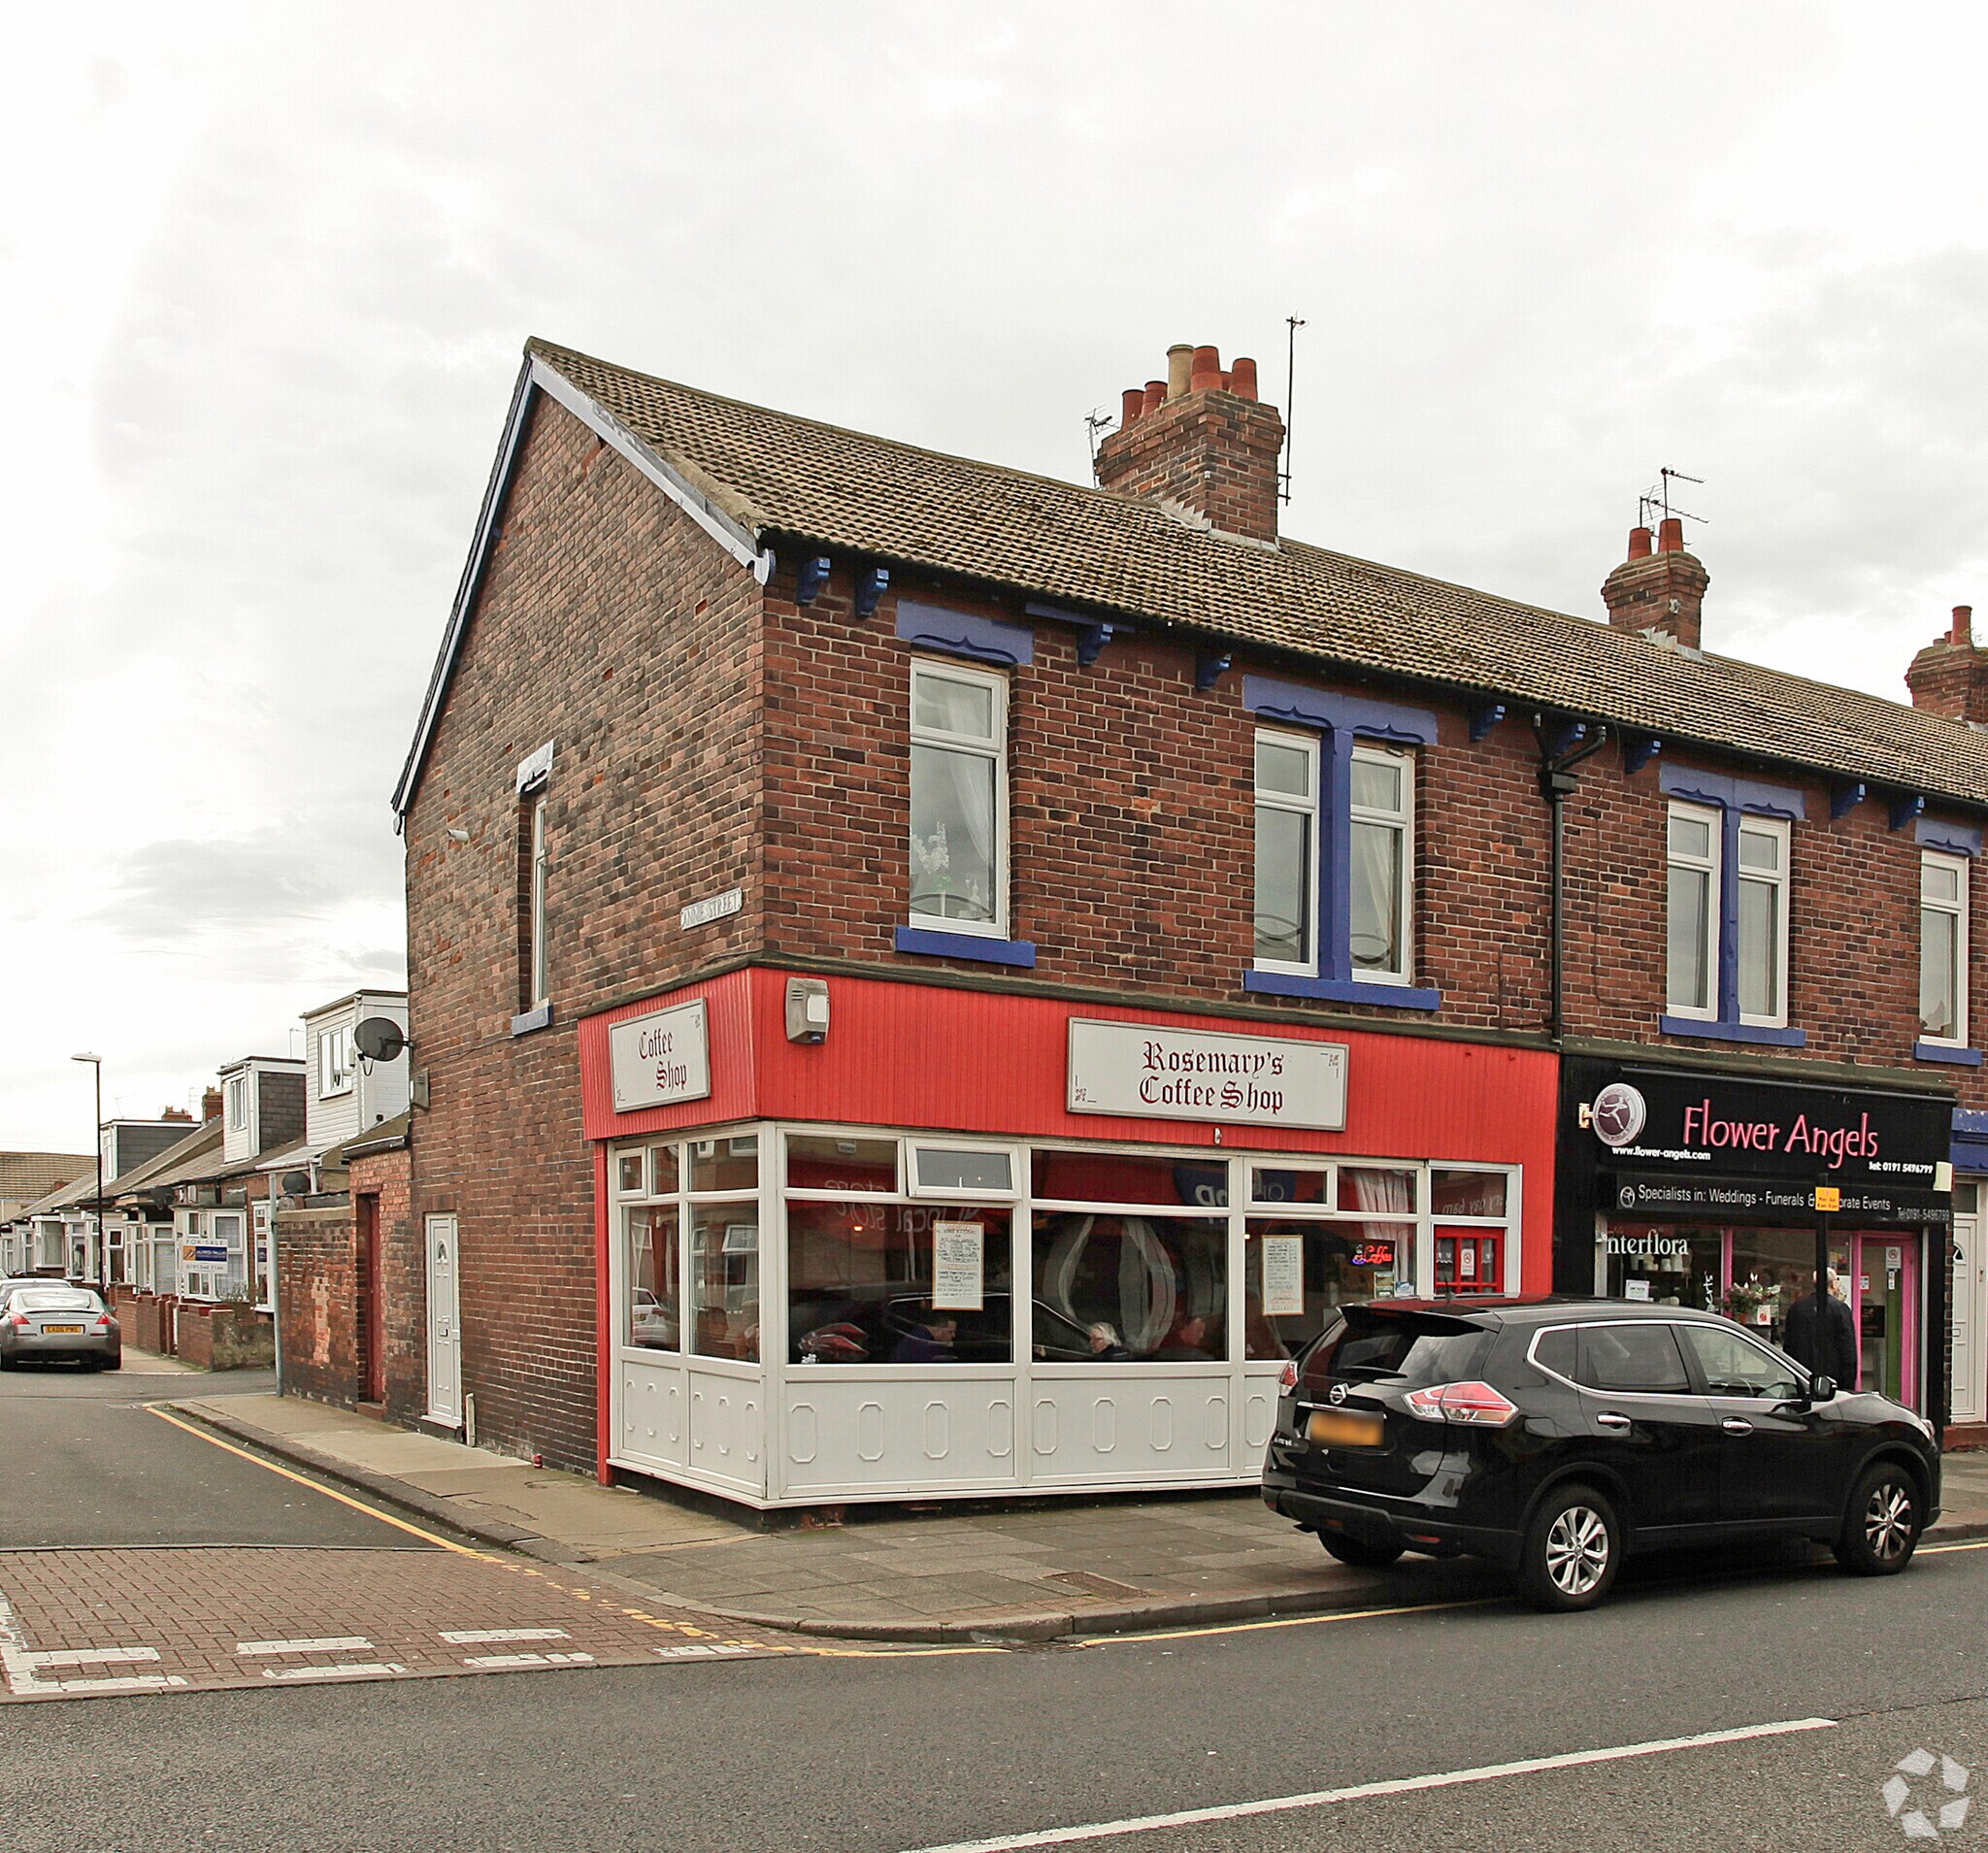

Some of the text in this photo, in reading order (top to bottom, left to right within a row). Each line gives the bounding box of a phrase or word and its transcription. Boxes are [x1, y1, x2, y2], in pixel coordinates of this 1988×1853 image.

[682, 893, 737, 928] ANNE STREET
[638, 1027, 674, 1060] Coffee
[1142, 1041, 1284, 1079] Rosemary's
[655, 1060, 687, 1095] Shop
[1139, 1075, 1284, 1115] Coffee Shop
[1683, 1099, 1780, 1150] Flower
[1783, 1112, 1878, 1169] Angels
[1611, 1145, 1711, 1161] www.flower-angels.com
[1883, 1162, 1901, 1173] 0191
[1638, 1183, 1691, 1202] Specialists
[1694, 1187, 1706, 1202] in:
[1708, 1188, 1757, 1208] Weddings
[1765, 1190, 1805, 1208] Funerals
[1862, 1196, 1891, 1211] Events
[1607, 1228, 1689, 1255] nterflora
